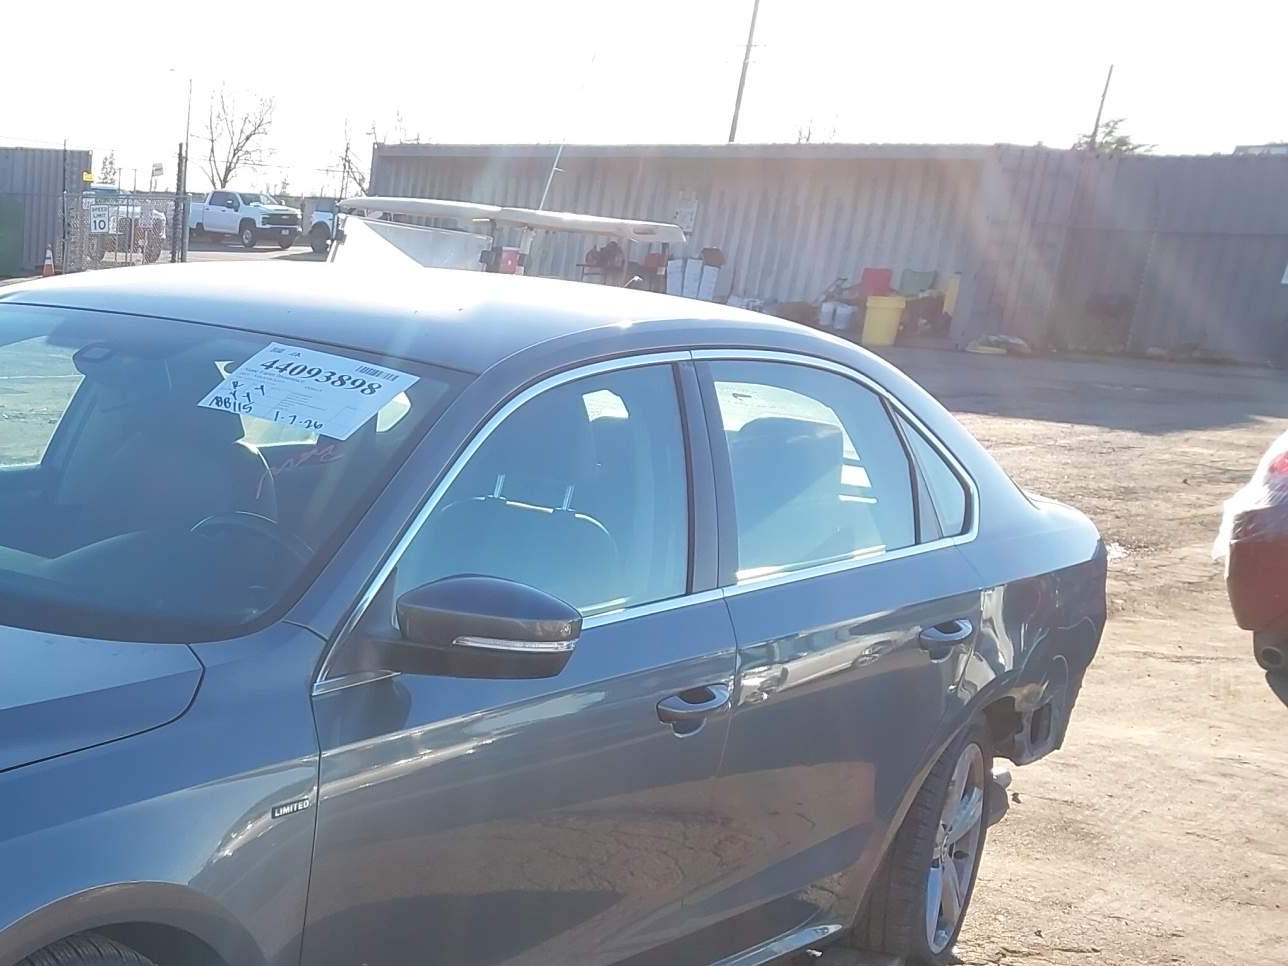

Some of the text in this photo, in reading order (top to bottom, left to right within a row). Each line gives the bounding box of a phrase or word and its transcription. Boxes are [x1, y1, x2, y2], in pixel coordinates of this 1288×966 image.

[93, 220, 106, 230] 10
[261, 359, 383, 396] 44093898
[274, 800, 309, 816] LIMITED
